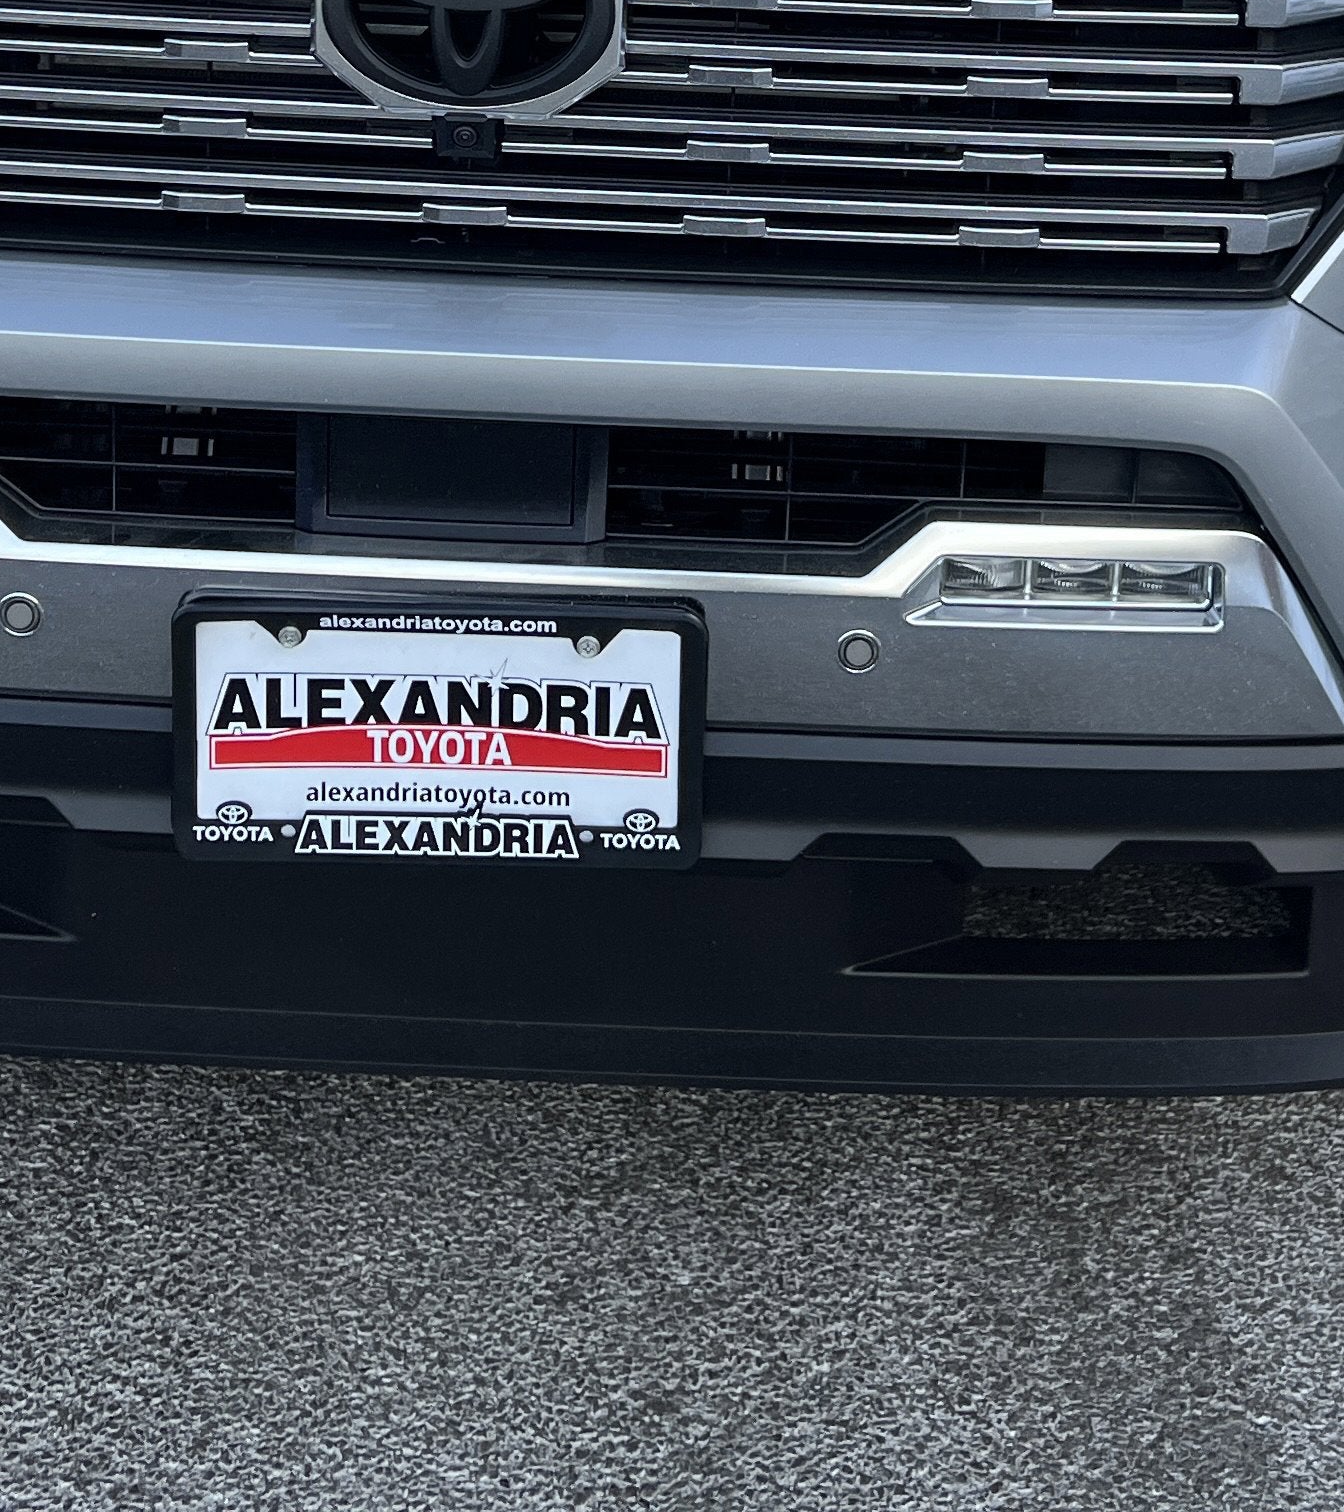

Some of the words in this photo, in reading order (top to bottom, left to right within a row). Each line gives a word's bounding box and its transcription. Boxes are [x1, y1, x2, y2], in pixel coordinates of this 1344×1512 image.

[318, 614, 558, 635] alexandriatoyota.com
[211, 676, 666, 742] ALEXANDRIA
[365, 728, 513, 766] TOYOTA
[305, 781, 572, 808] alexandriatoyota.com
[191, 824, 275, 844] TOYOTA
[295, 816, 580, 858] ALEXANDRIA
[599, 831, 682, 852] TOYOTA
